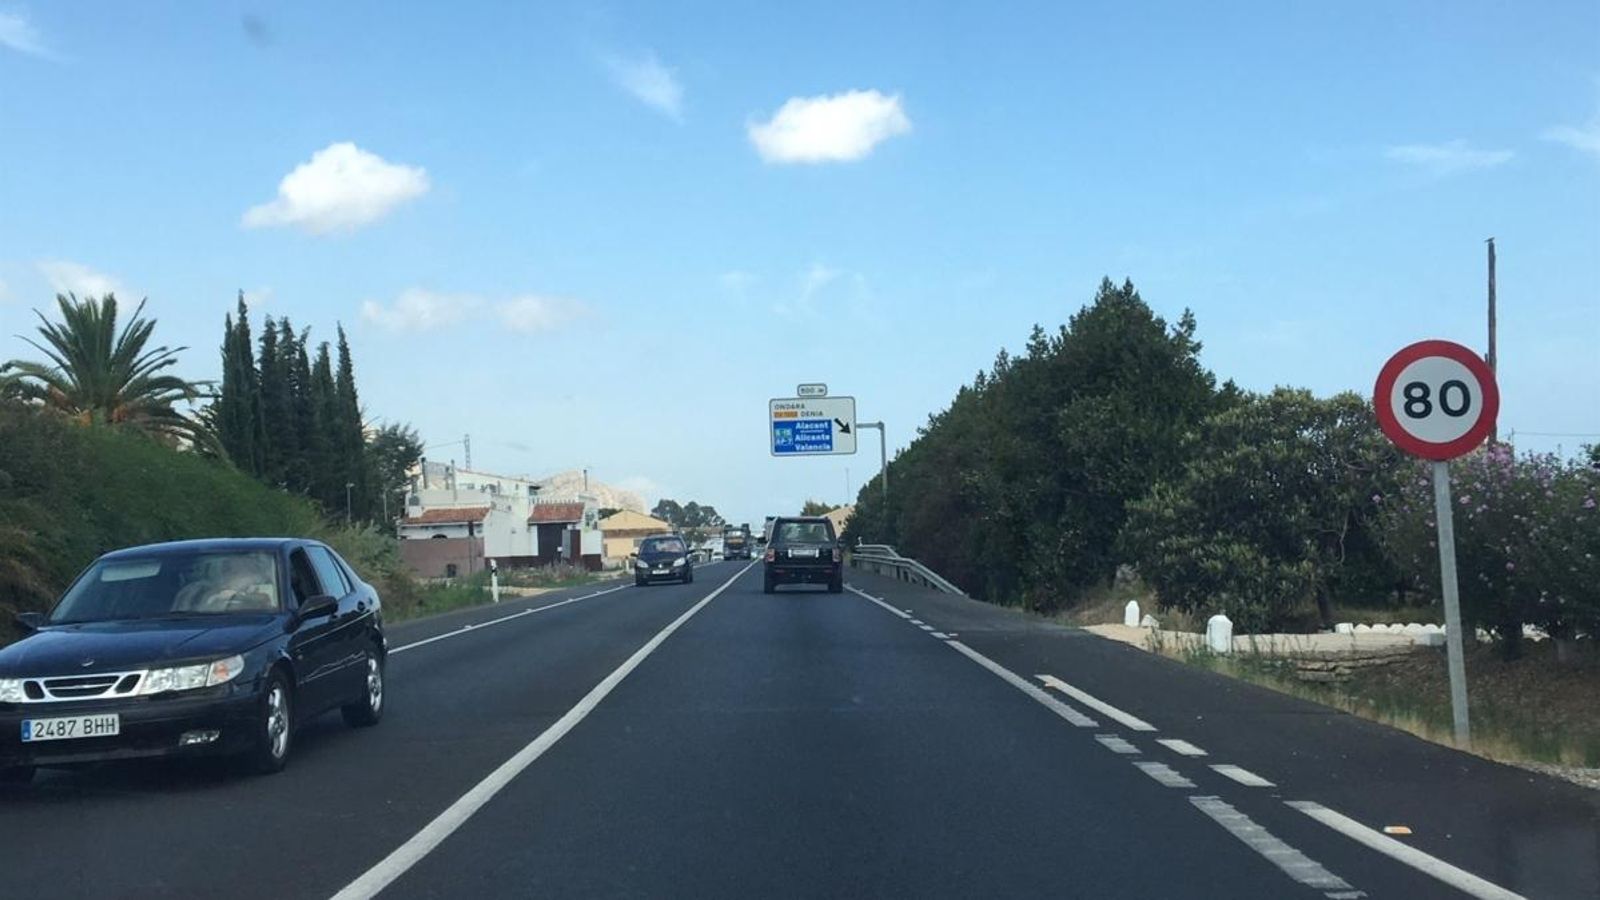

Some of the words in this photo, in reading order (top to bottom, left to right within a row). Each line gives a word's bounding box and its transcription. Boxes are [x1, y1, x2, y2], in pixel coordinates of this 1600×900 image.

[1403, 379, 1471, 419] 80
[794, 434, 830, 442] Alicante
[794, 443, 831, 451] Valencia
[34, 719, 77, 738] 2487
[83, 717, 116, 735] BHH
